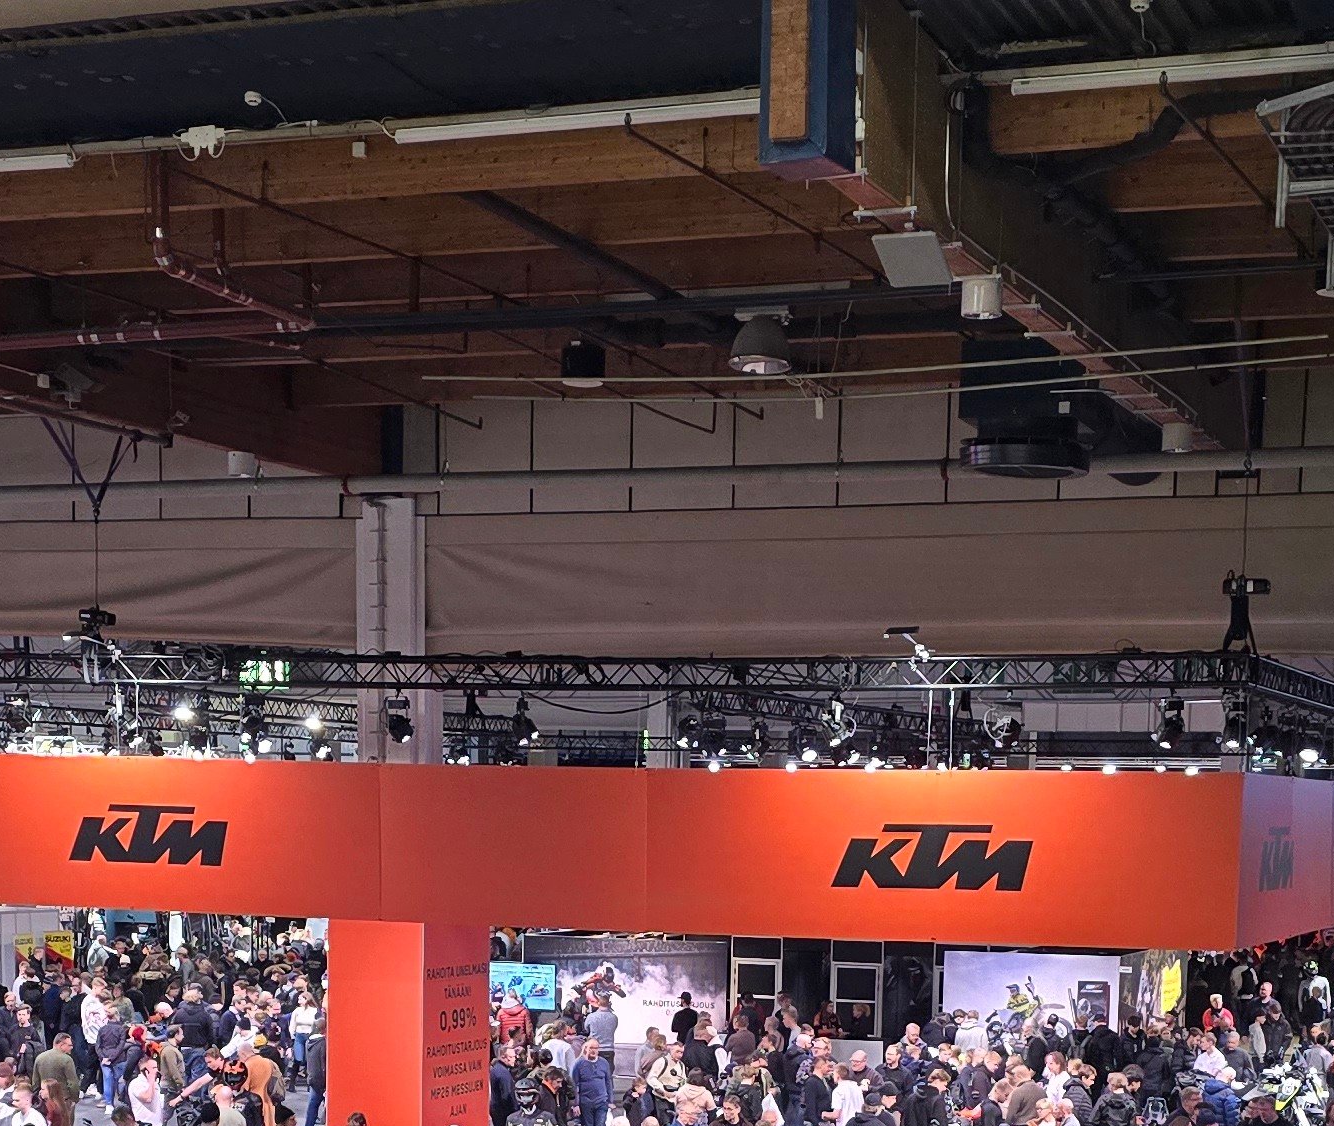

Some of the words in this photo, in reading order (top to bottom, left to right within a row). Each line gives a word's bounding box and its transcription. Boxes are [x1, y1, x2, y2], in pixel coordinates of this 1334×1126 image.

[69, 804, 228, 866] KTM
[831, 824, 1033, 891] KTM
[1259, 826, 1295, 892] KTM
[45, 935, 71, 943] SUZUKI
[440, 1007, 476, 1032] 0,99%
[450, 1103, 467, 1117] AJAN
